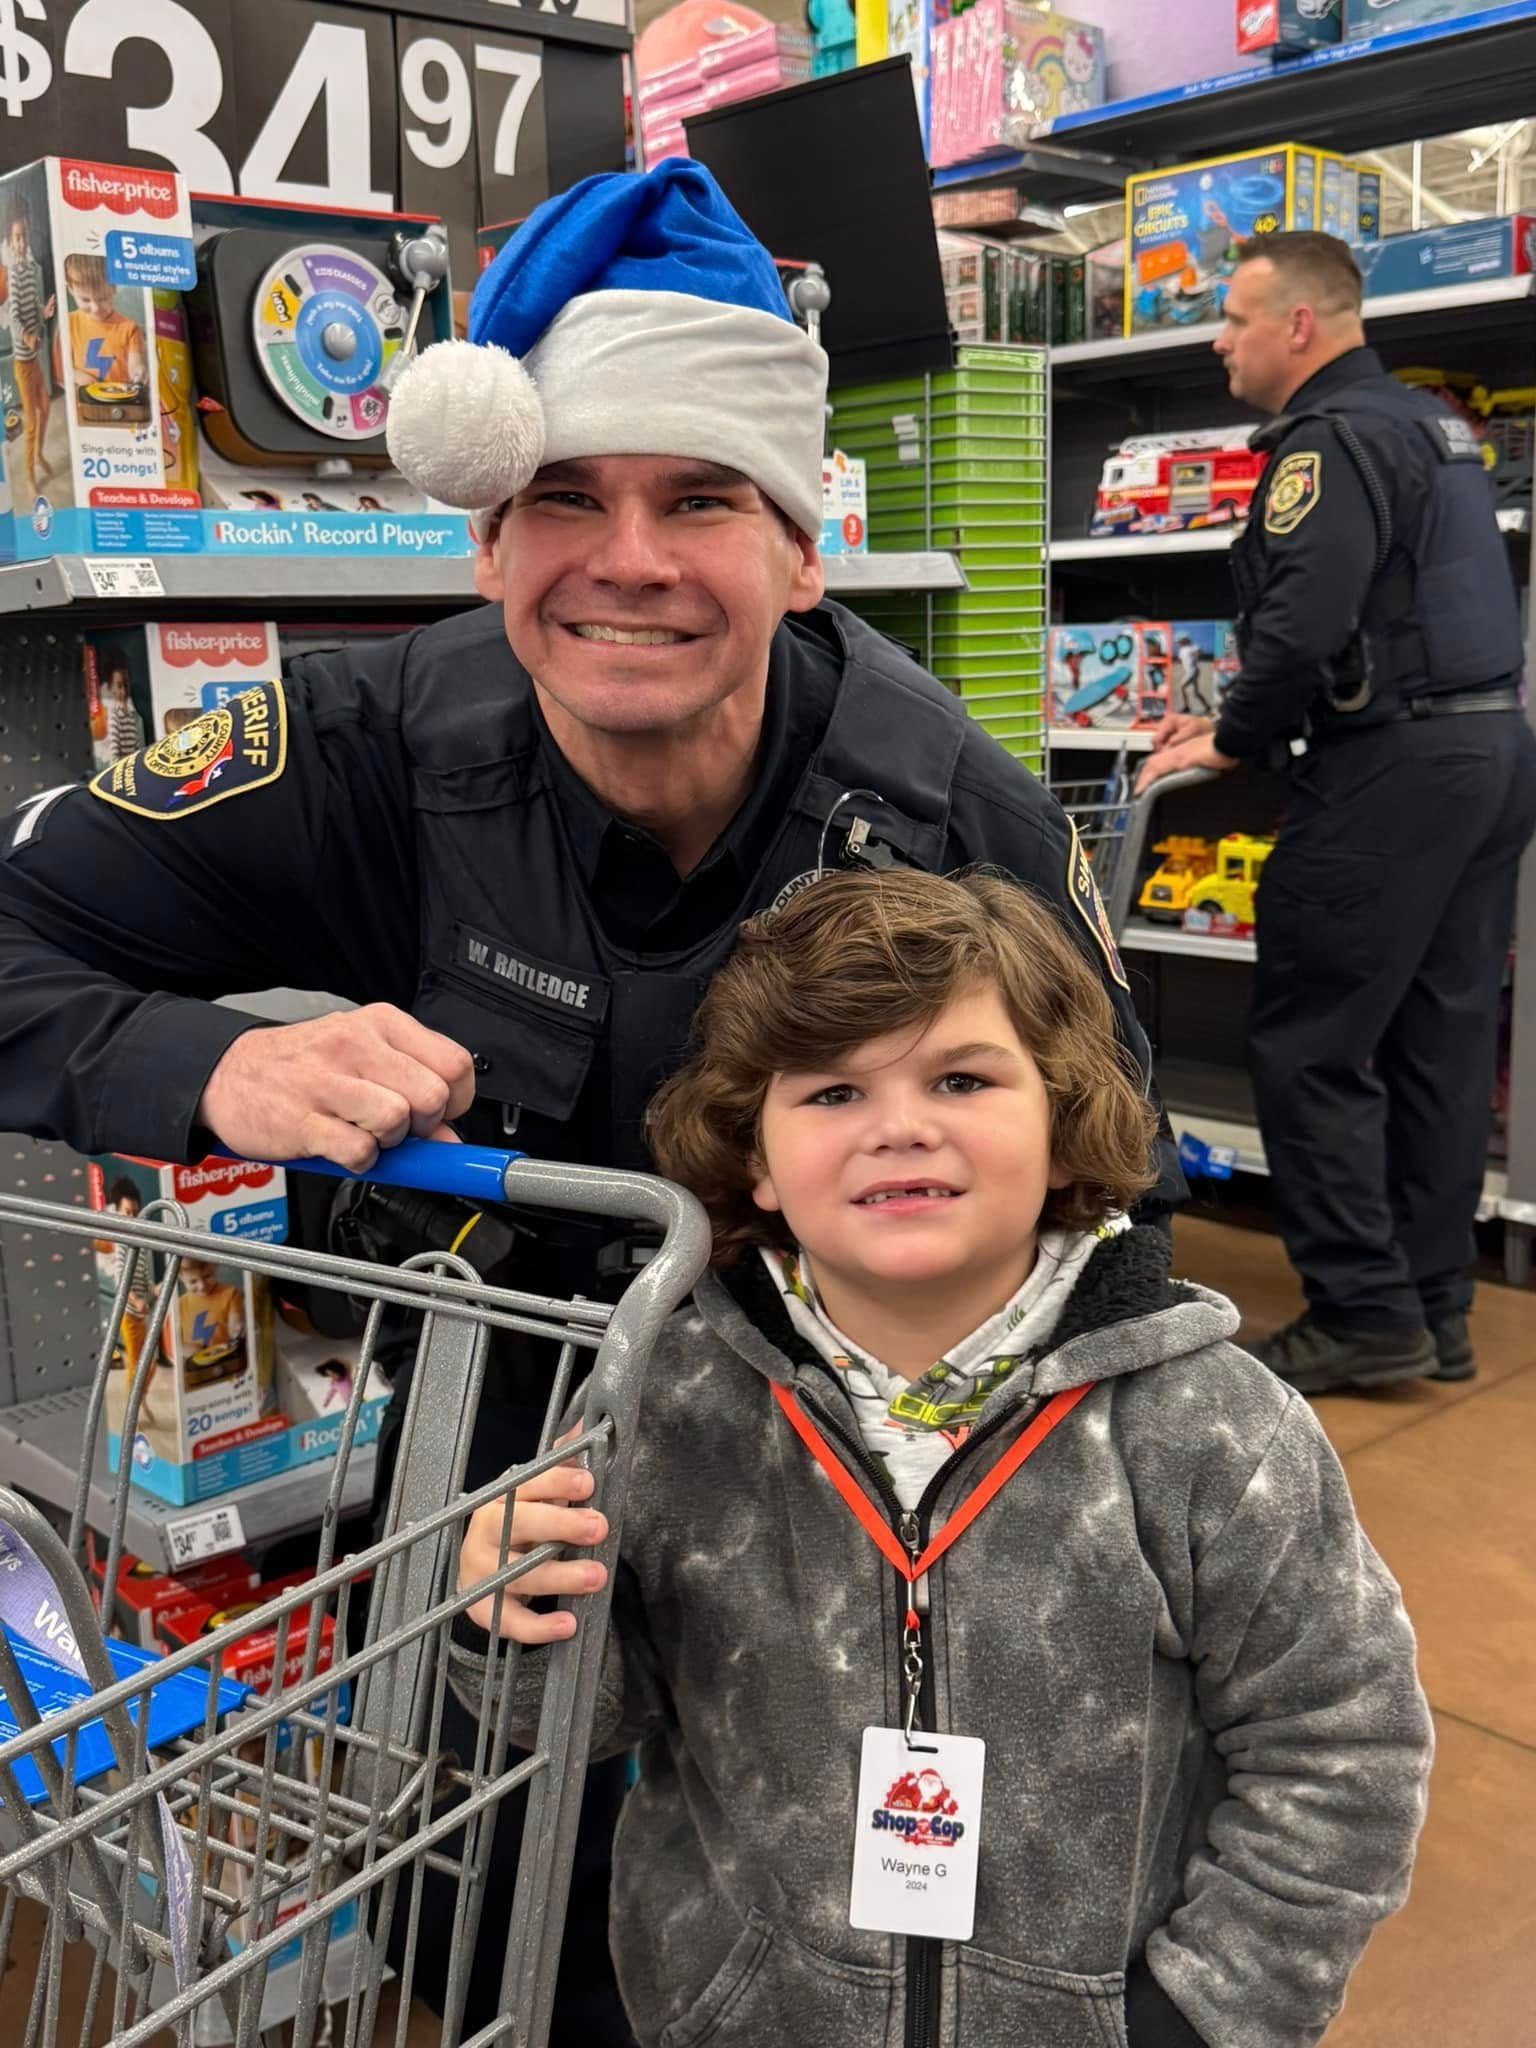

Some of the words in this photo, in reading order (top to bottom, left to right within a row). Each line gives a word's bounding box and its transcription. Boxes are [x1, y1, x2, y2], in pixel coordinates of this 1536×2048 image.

[66, 168, 172, 202] fisher-price
[121, 236, 138, 260] 5
[138, 242, 181, 259] albums
[82, 457, 111, 479] 20
[113, 462, 158, 477] songs!
[96, 491, 138, 505] Teaches
[138, 493, 148, 504] &
[219, 520, 298, 545] Rockin'
[303, 520, 378, 546] Record
[165, 630, 263, 655] fisher-price
[468, 938, 490, 969] W.
[492, 951, 591, 1010] RATLEDGE
[222, 1211, 239, 1234] 5
[239, 1209, 275, 1226] albums
[186, 1413, 213, 1438] 20
[871, 1808, 918, 1837] Shop
[930, 1814, 966, 1844] Cop
[881, 1857, 931, 1877] Wayne
[934, 1863, 948, 1878] G
[905, 1879, 928, 1891] 2024
